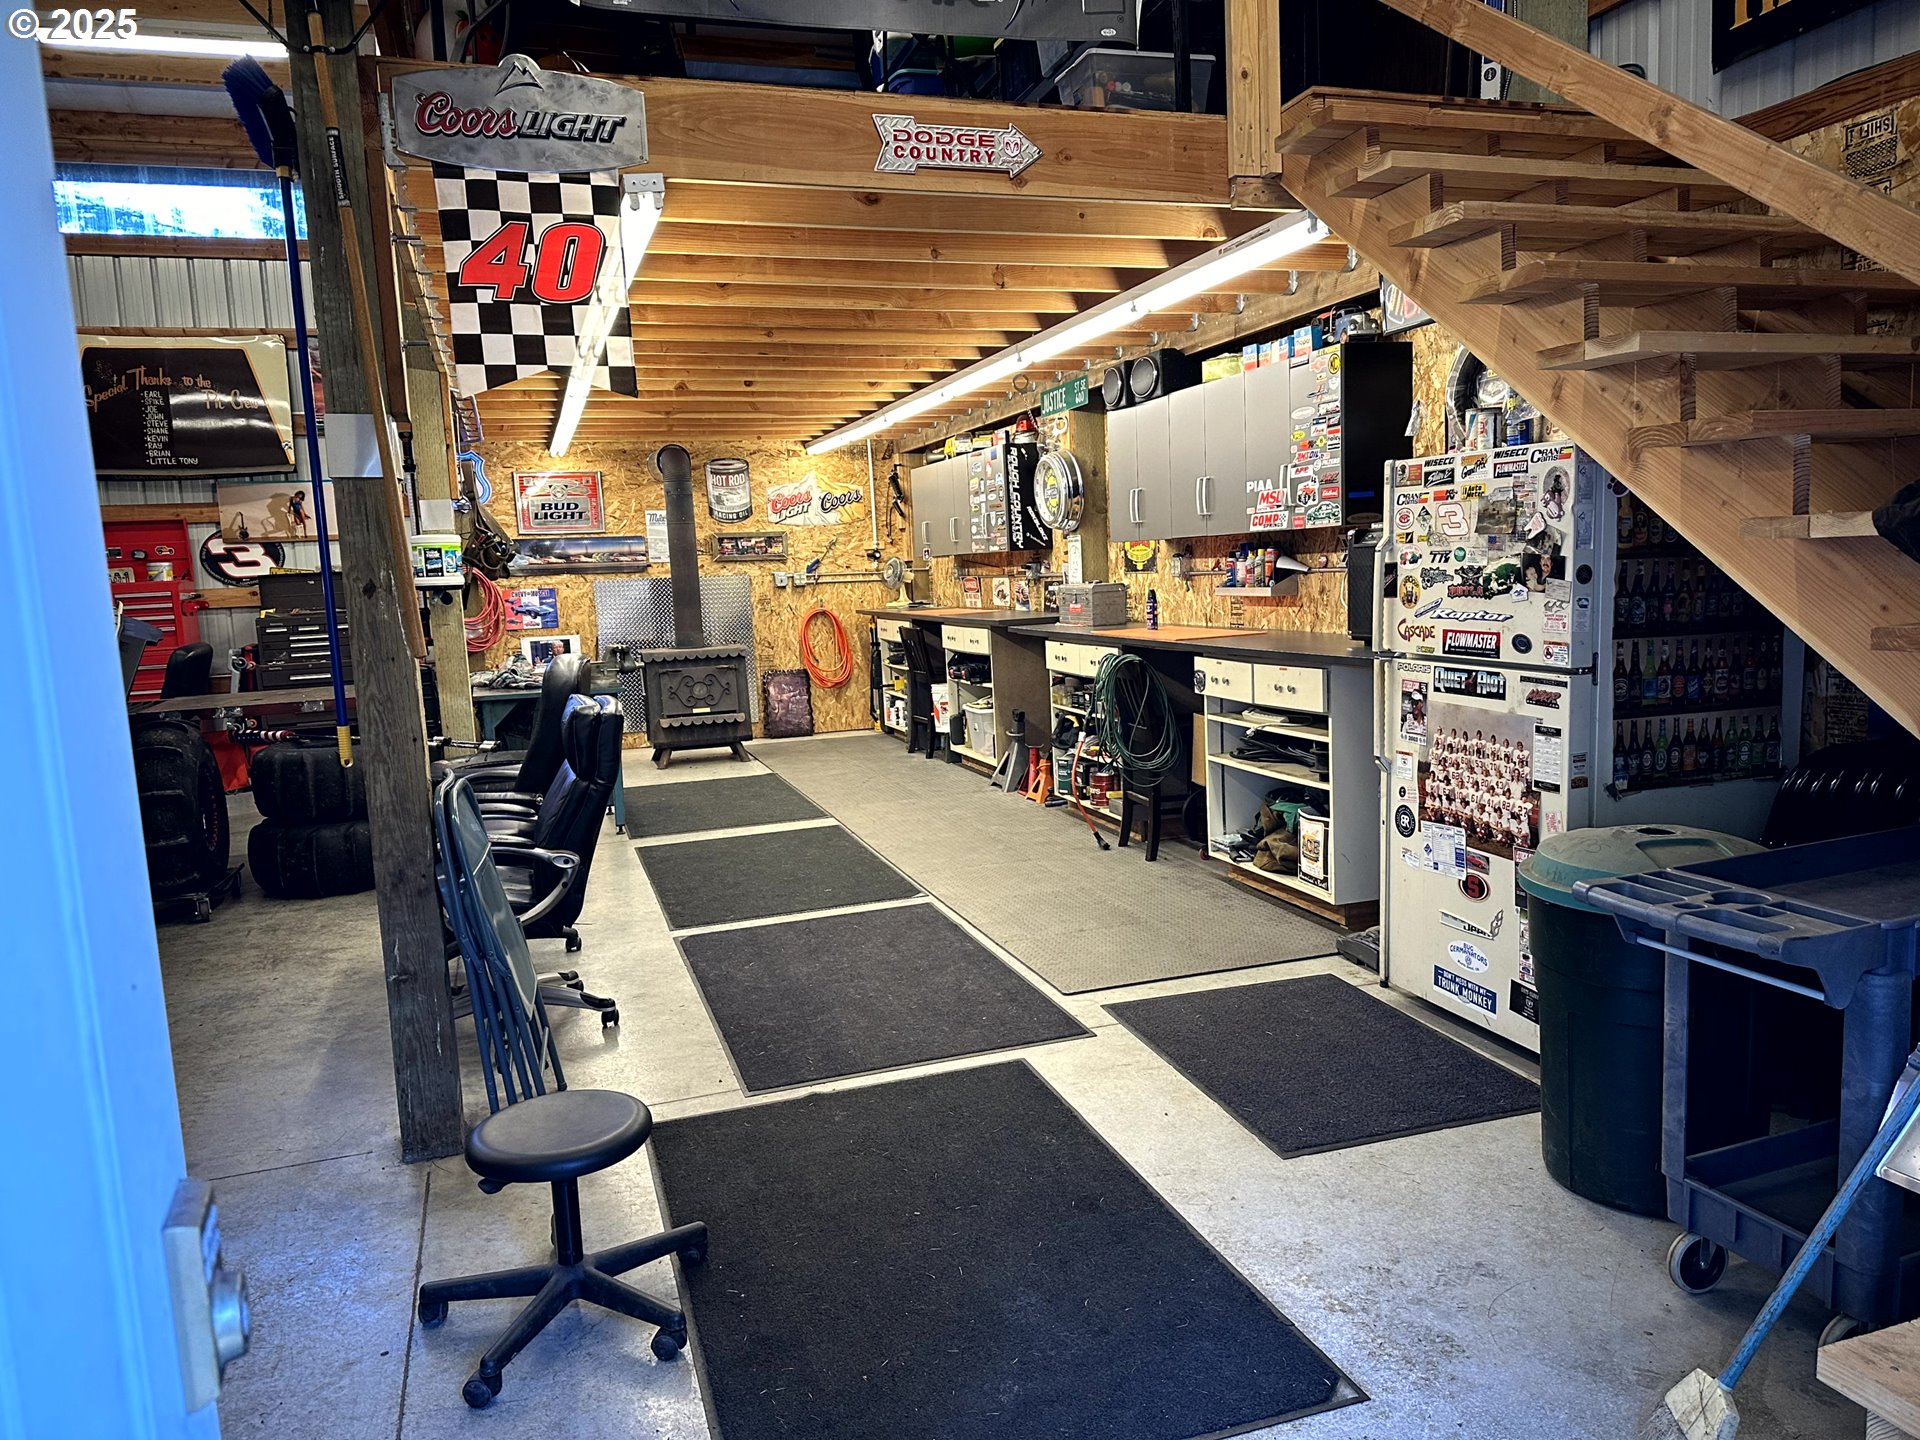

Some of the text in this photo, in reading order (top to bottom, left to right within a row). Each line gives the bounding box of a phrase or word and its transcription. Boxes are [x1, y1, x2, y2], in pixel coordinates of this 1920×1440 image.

[415, 91, 628, 144] Coors LIGHT
[892, 129, 996, 147] DODGE
[328, 136, 339, 168] SURFACE
[893, 144, 996, 164] COUNTRY
[334, 169, 345, 200] SMOOTH
[458, 219, 608, 304] 40
[82, 365, 212, 413] Special Thanks to the
[144, 390, 161, 398] EARL
[145, 405, 158, 413] JOE
[230, 389, 259, 410] Crew
[1041, 387, 1067, 415] JUSTICE
[146, 420, 168, 428] STEVE
[146, 427, 169, 435] SHANE
[147, 442, 163, 450] RAY
[1494, 448, 1529, 459] WISECO
[150, 457, 198, 465] LITTLE TONY
[1010, 446, 1020, 490] ROUGH
[1424, 457, 1456, 468] WISECO
[1495, 462, 1528, 477] FLOWMASTER
[710, 472, 746, 488] HOT ROD
[1246, 479, 1274, 493] PIAA
[541, 502, 579, 511] BUD
[769, 489, 863, 513] Coors Coors
[534, 511, 587, 520] LIGHT
[738, 510, 749, 518] OIL
[773, 503, 811, 524] LIGHT
[1012, 492, 1024, 549] COUNTRY
[1252, 513, 1280, 527] COMP
[1437, 502, 1469, 537] 3
[207, 537, 278, 578] 3
[1430, 608, 1514, 622] Raptor
[1397, 618, 1436, 642] CASCADE
[1445, 631, 1498, 651] FLOWMASTER
[1397, 661, 1431, 674] POLARIS
[1434, 667, 1467, 693] QUIET
[1476, 670, 1506, 695] RIOT
[1502, 800, 1511, 810] 82
[1467, 876, 1480, 899] S
[1437, 976, 1460, 998] TRUNK
[1461, 985, 1493, 1010] MONKEY
[1443, 970, 1456, 981] DON'T
[1479, 986, 1487, 996] MY
